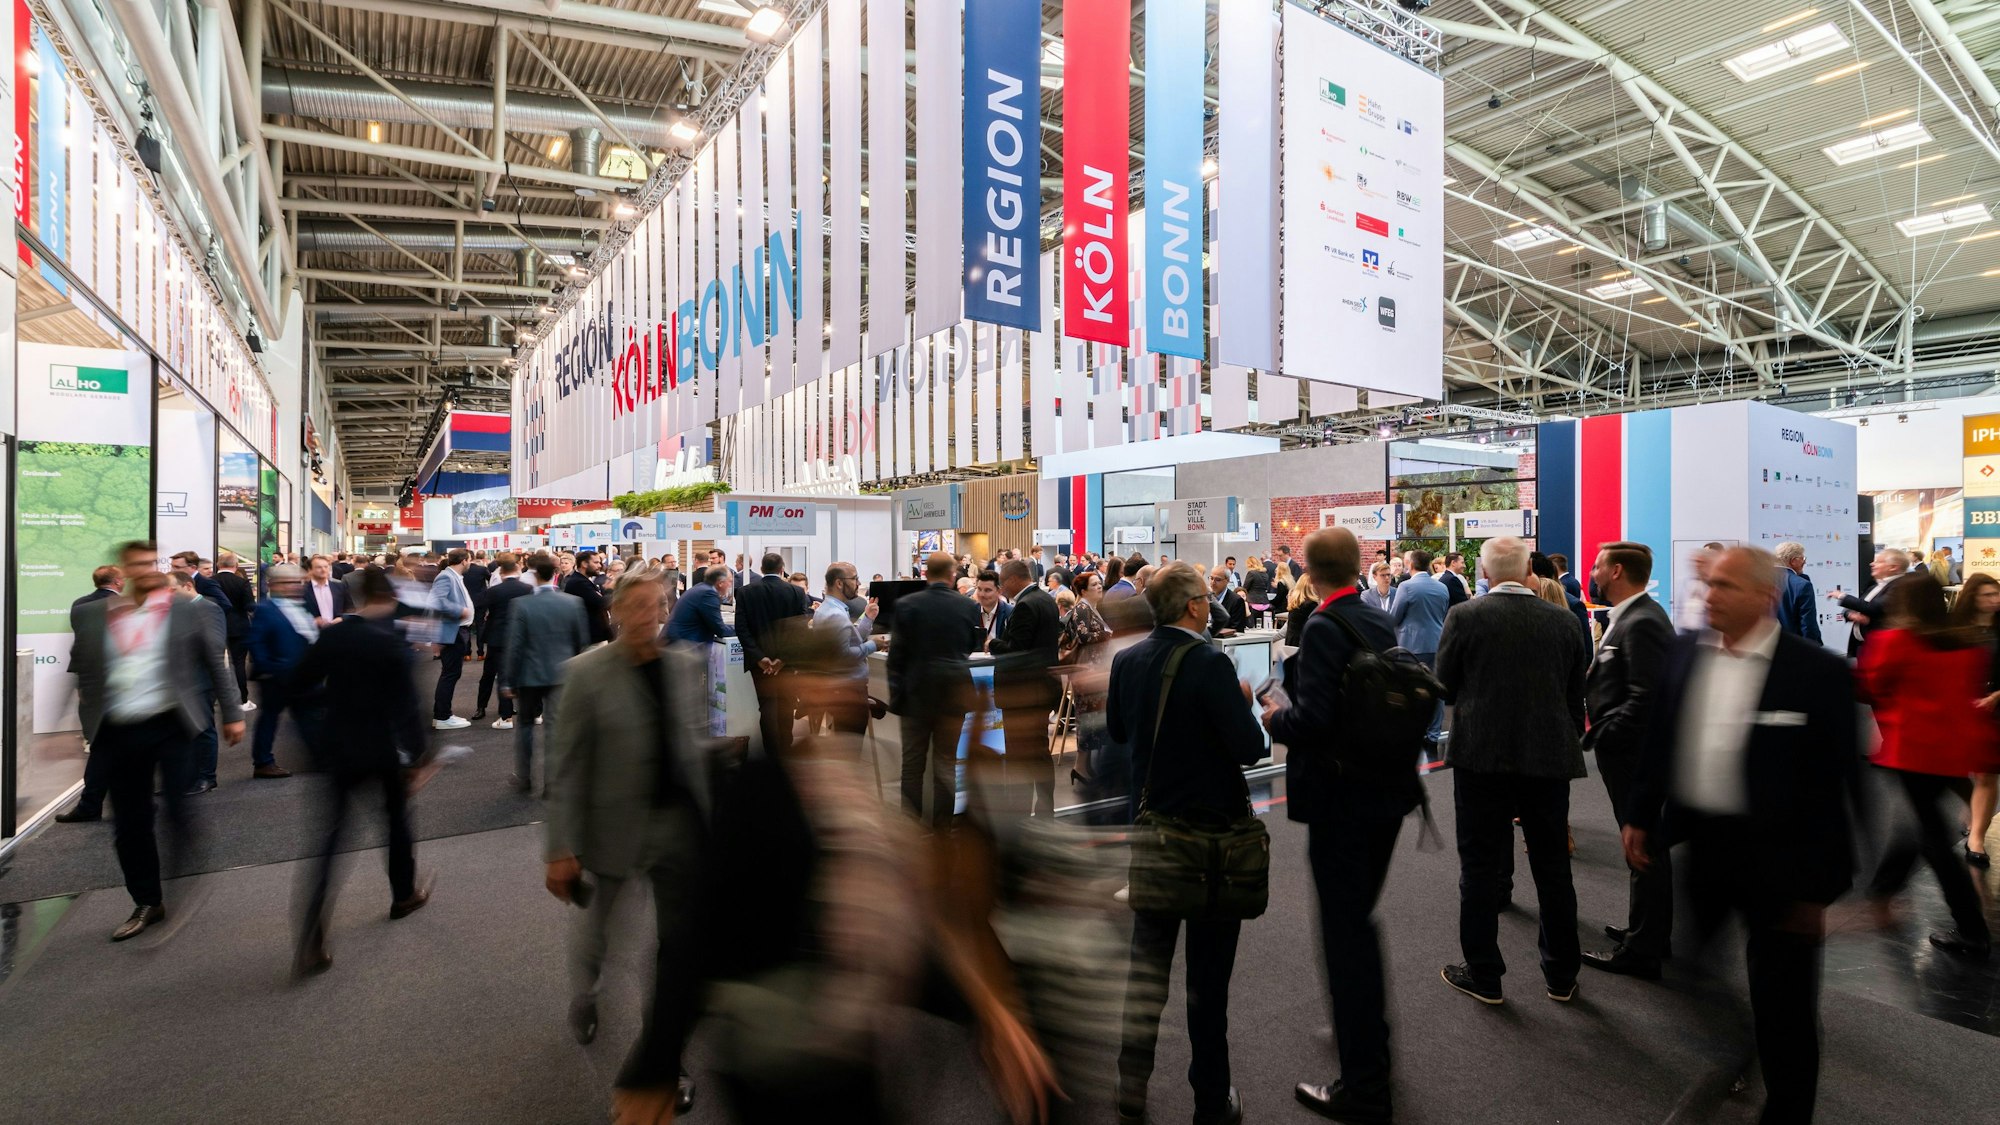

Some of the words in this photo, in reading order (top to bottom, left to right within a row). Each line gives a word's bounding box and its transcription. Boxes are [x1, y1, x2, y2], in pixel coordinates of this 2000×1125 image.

[50, 171, 58, 255] ONN
[986, 68, 1023, 307] REGION
[1075, 164, 1114, 324] KÖLN
[1162, 179, 1190, 339] BONN
[1380, 306, 1394, 317] WFEG
[555, 300, 613, 403] REGION
[1781, 428, 1804, 443] REGION
[923, 510, 946, 518] AHRWEILER
[1000, 492, 1025, 512] ECE
[1187, 501, 1208, 509] STADT.
